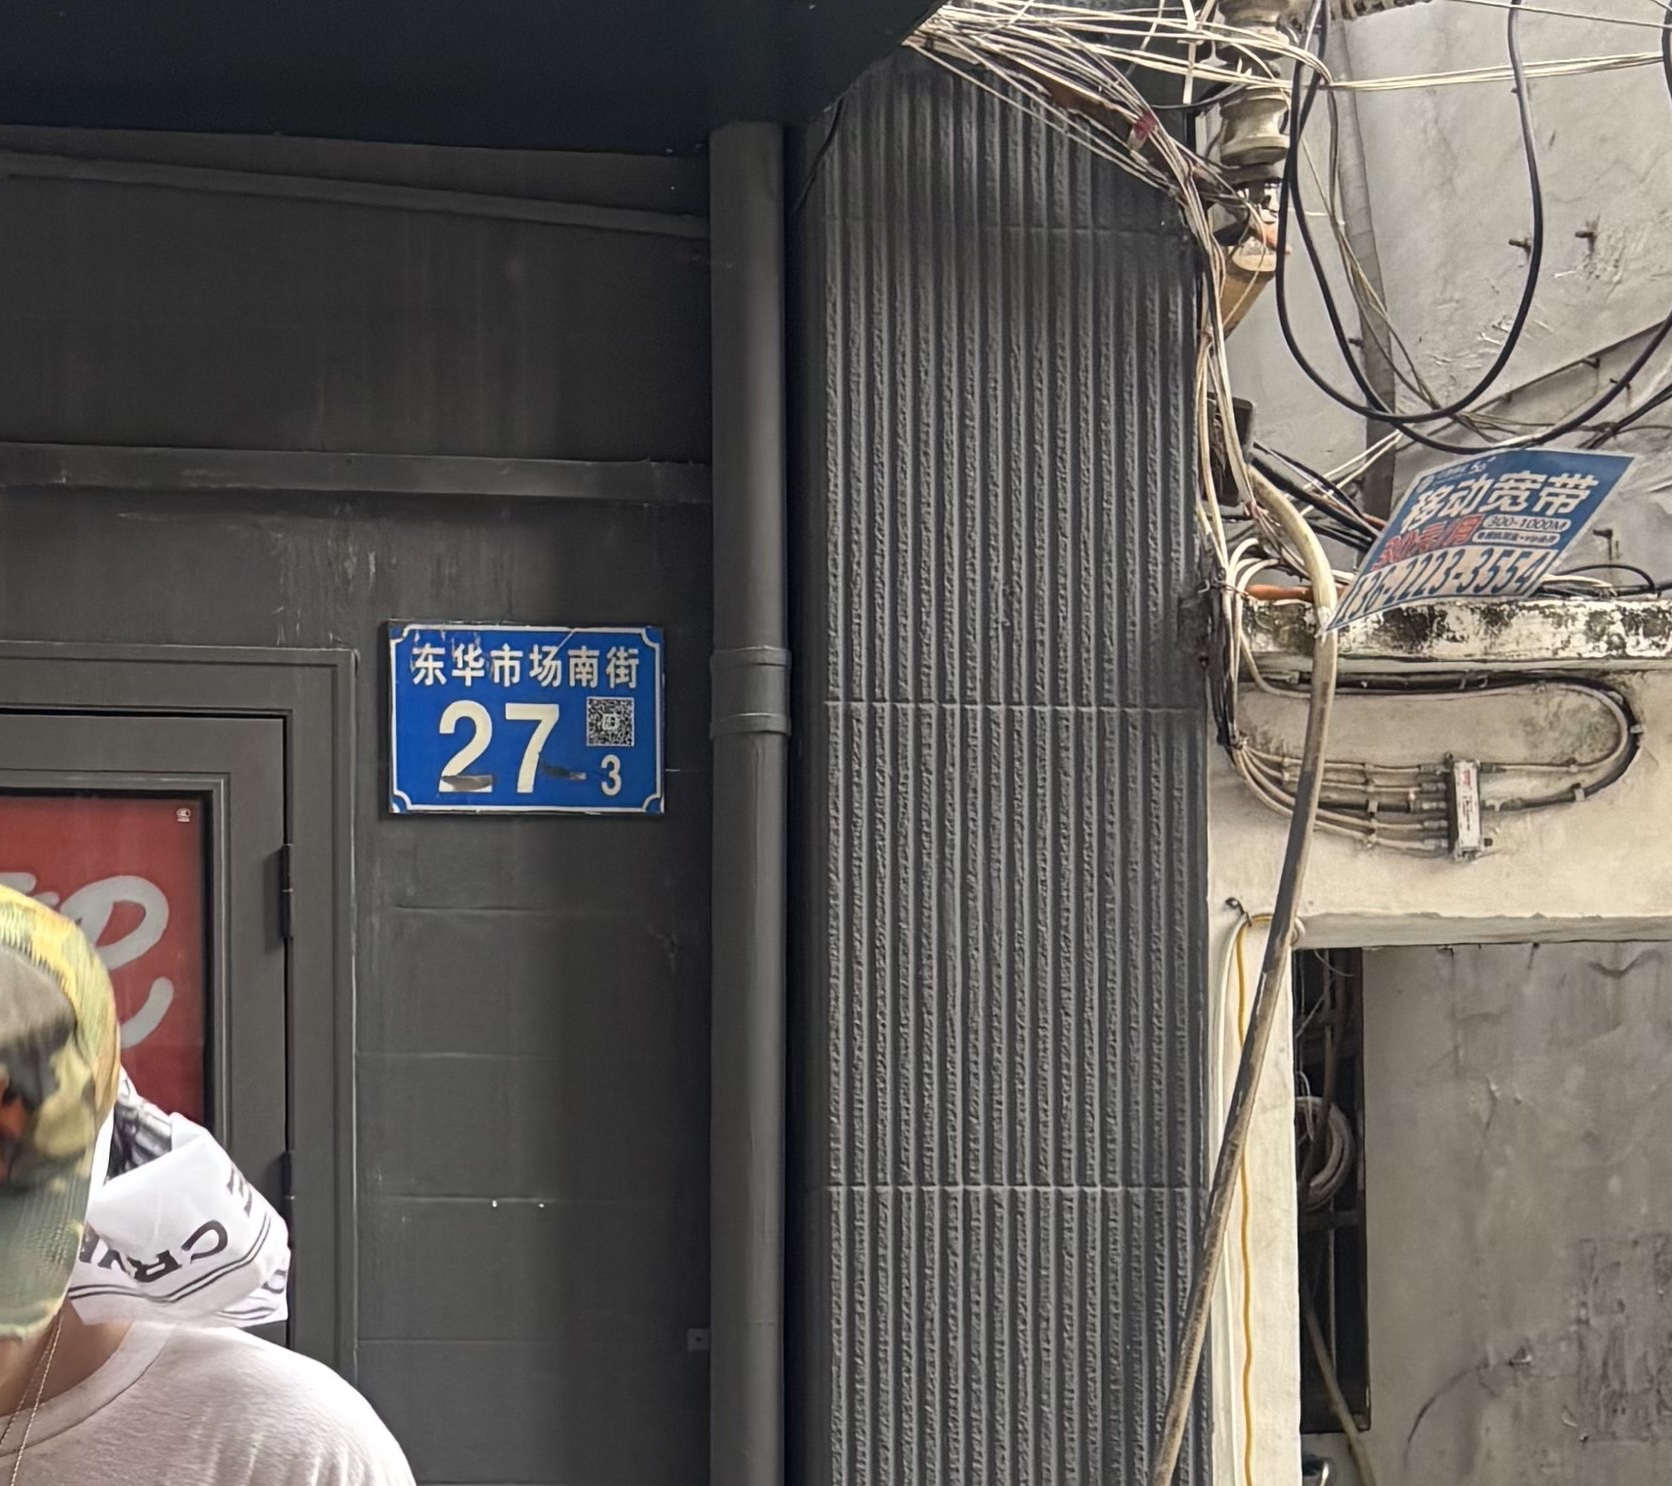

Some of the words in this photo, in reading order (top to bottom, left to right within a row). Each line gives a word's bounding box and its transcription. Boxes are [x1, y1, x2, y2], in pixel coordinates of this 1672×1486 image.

[1400, 470, 1599, 534] 移动宽带
[412, 643, 640, 688] 东华市场南街
